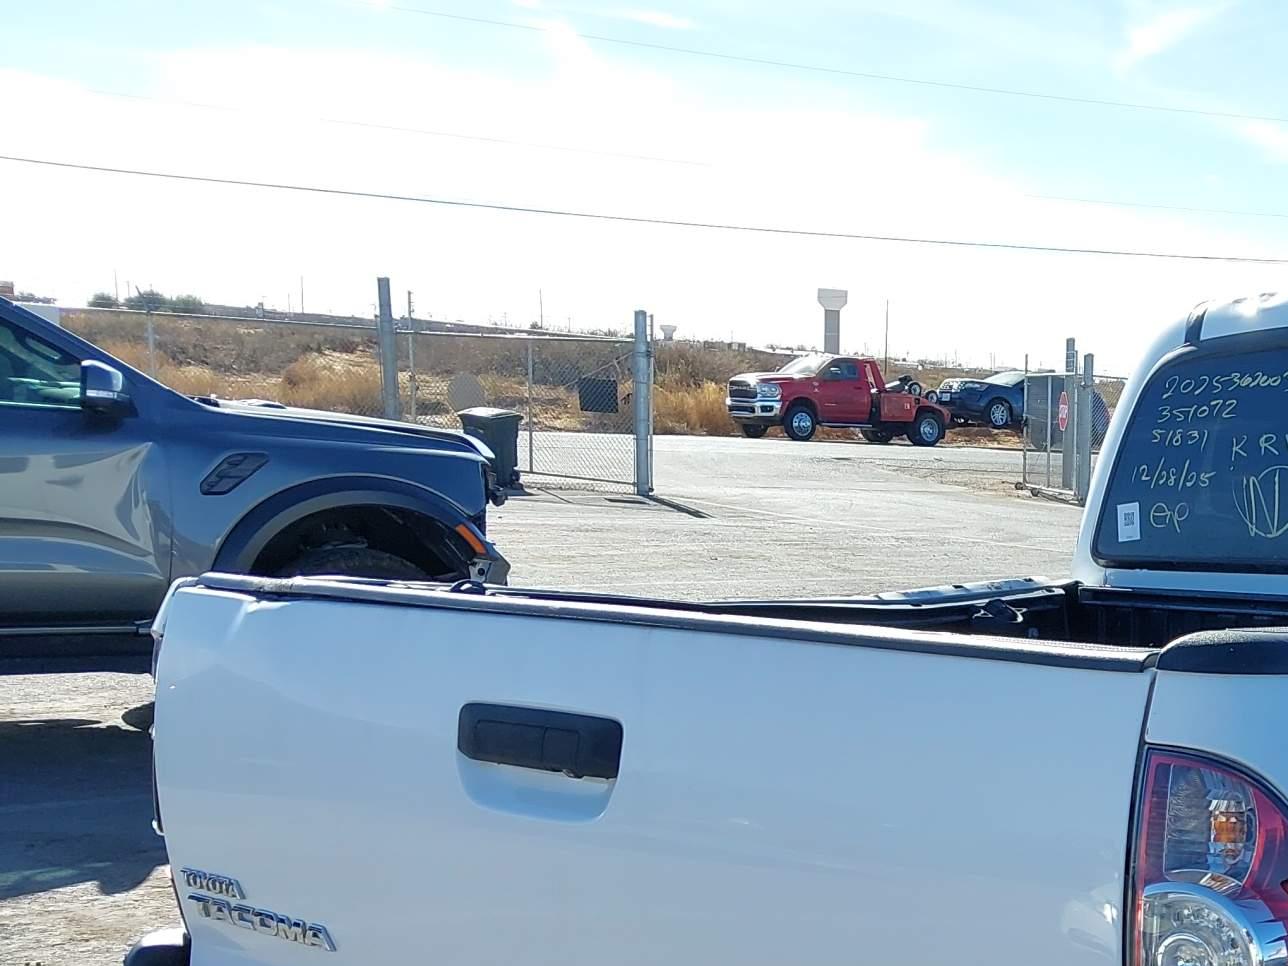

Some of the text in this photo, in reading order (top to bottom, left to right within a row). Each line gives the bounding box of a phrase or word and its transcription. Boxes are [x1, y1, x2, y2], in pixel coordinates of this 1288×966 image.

[1259, 433, 1279, 456] R
[180, 867, 246, 900] TOYOTA
[187, 892, 337, 952] TACOMA
